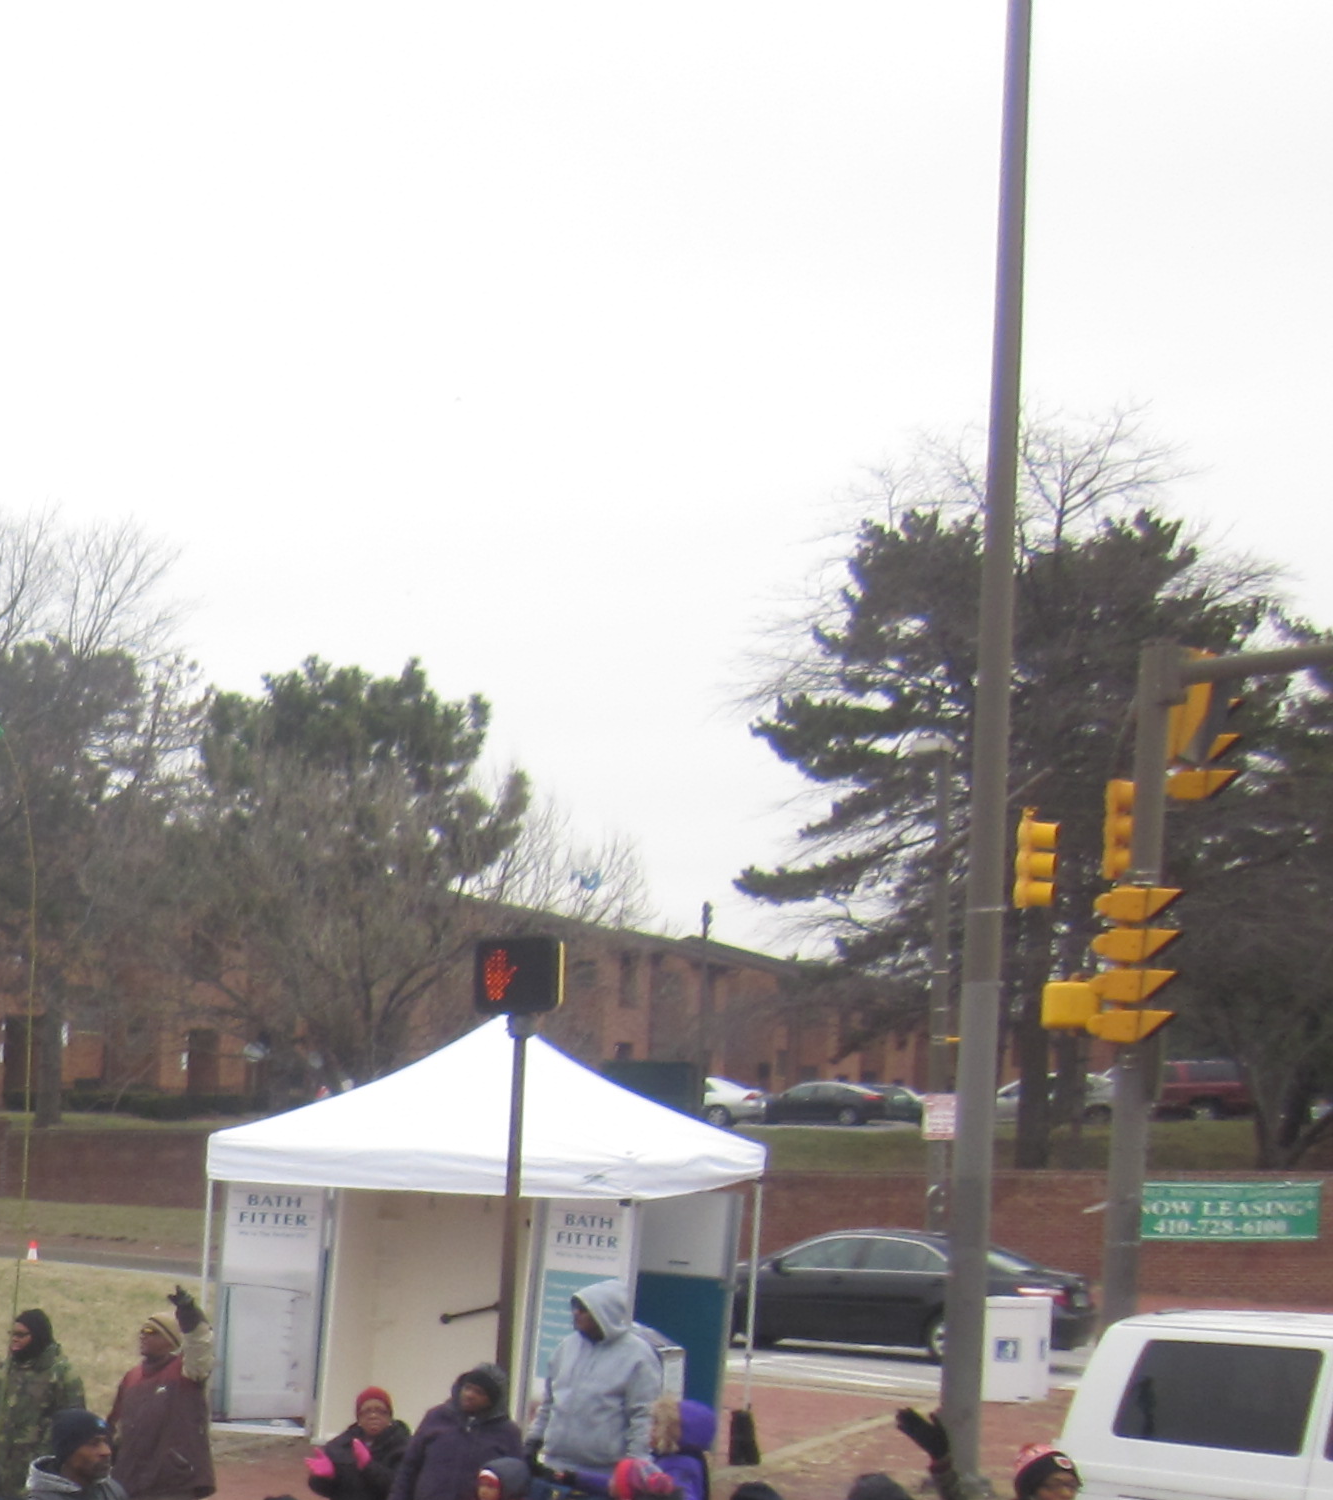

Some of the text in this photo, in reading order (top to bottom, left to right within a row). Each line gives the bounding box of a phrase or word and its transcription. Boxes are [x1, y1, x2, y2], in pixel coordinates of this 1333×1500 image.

[247, 1194, 302, 1208] BATH
[239, 1211, 308, 1226] FITTER
[565, 1212, 613, 1230] BATH
[556, 1231, 618, 1249] FITTER
